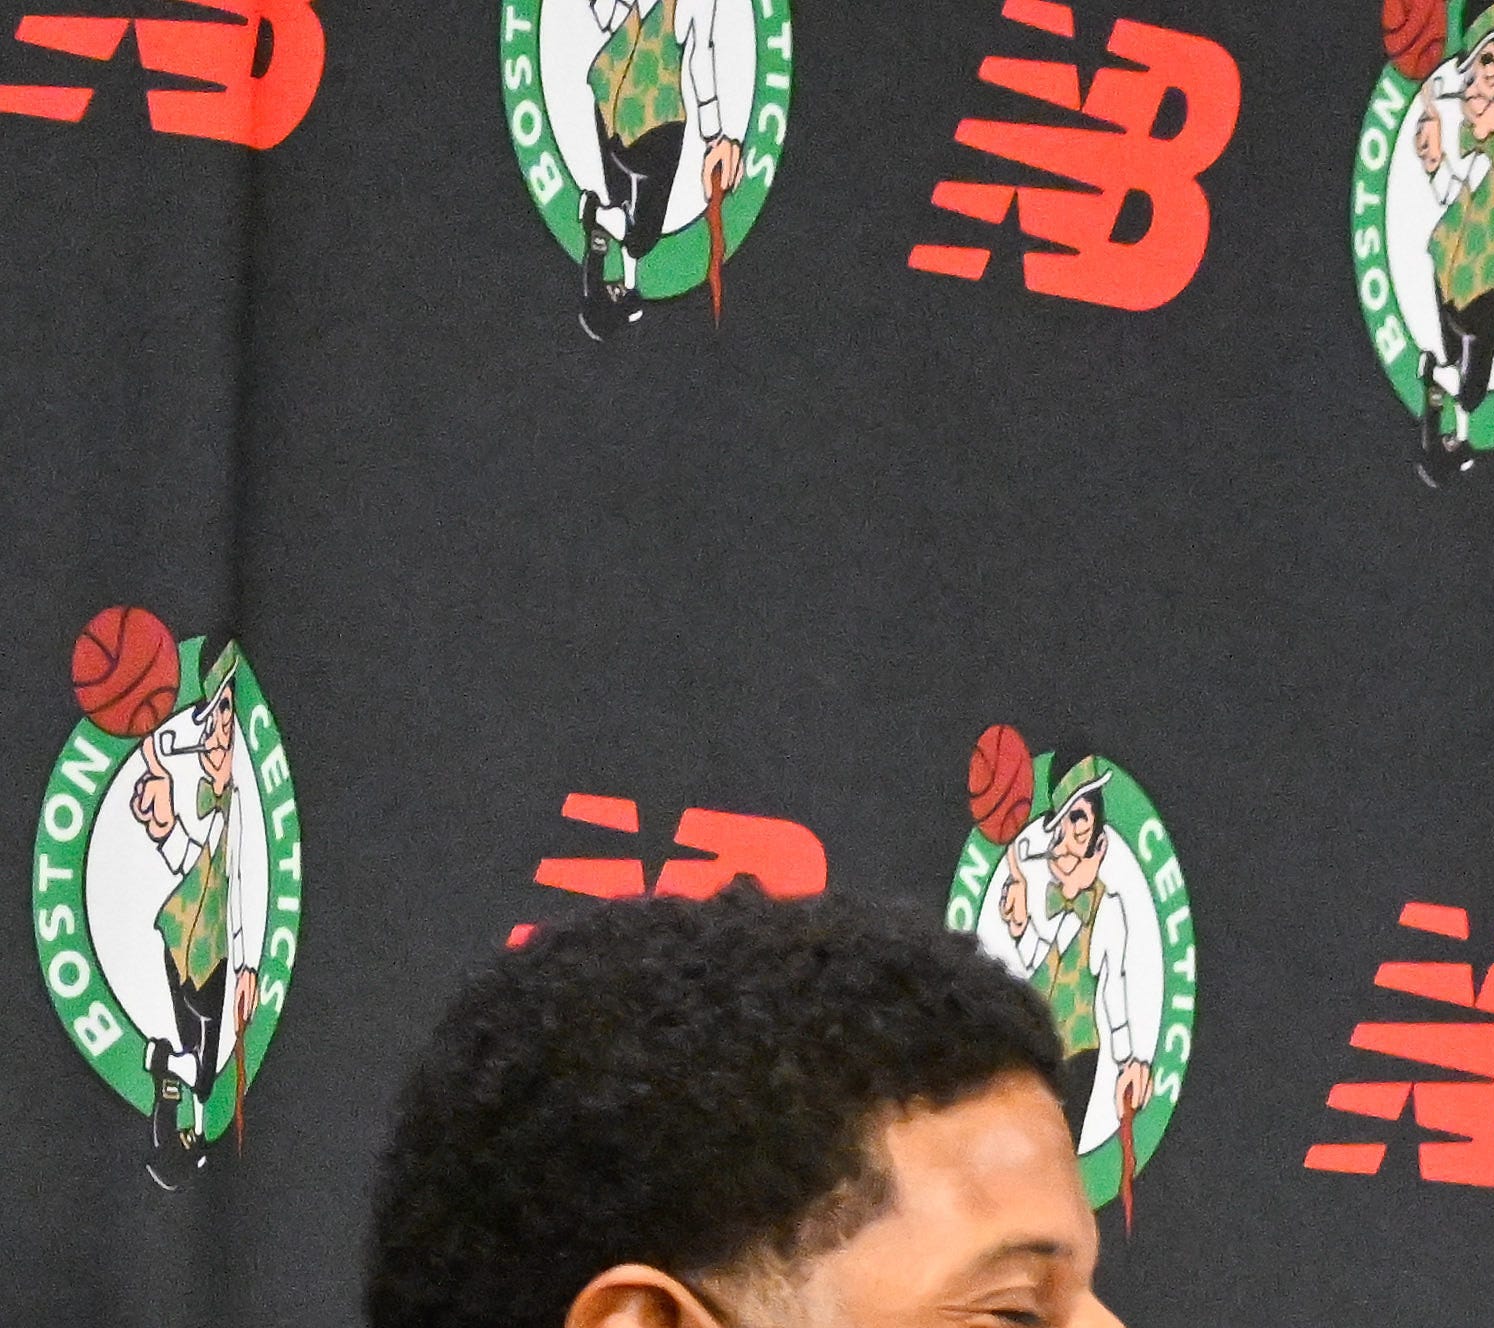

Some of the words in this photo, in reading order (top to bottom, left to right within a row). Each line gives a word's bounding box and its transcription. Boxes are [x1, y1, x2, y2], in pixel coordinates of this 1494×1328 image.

[504, 0, 562, 203] BOST
[744, 0, 791, 185] TICS
[1354, 79, 1408, 362] BOSTON
[38, 735, 121, 1057] BOSTON
[247, 703, 300, 1015] CELTICS
[1138, 818, 1195, 1103] CELTICS
